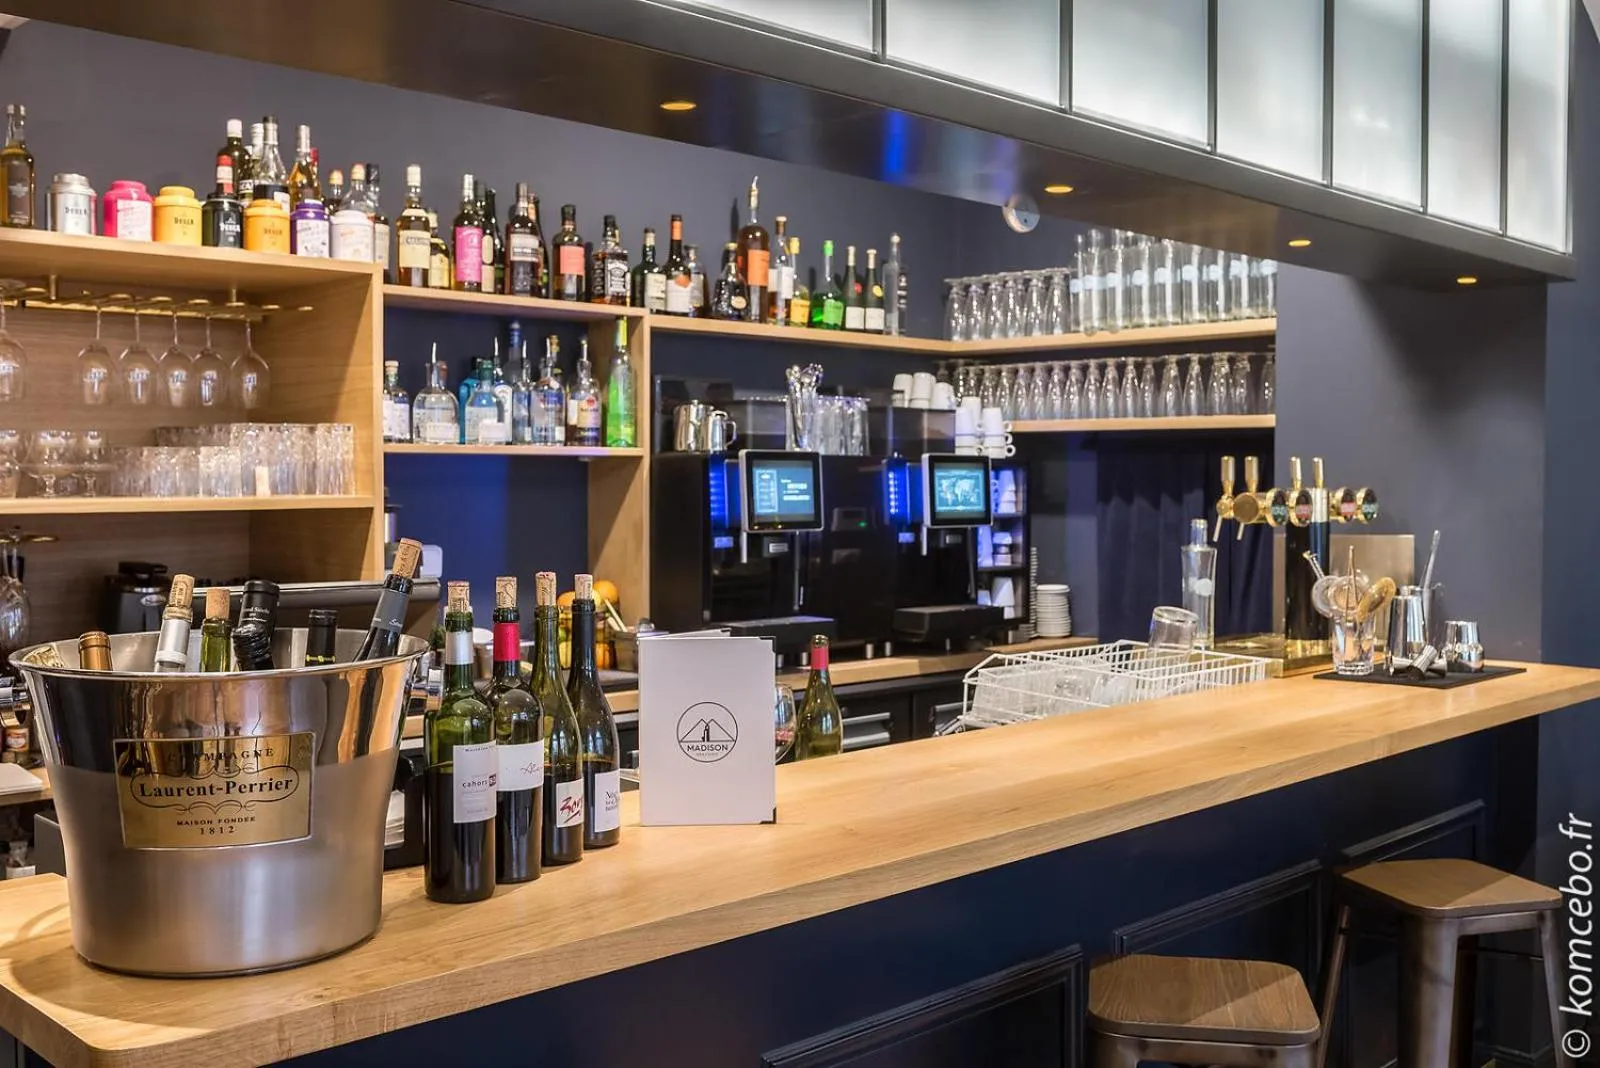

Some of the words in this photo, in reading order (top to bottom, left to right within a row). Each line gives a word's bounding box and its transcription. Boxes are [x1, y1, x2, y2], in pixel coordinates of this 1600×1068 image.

[687, 744, 728, 752] MADISON
[139, 777, 293, 797] Laurent-Perrier
[462, 779, 488, 789] cahors
[200, 826, 235, 835] 1812
